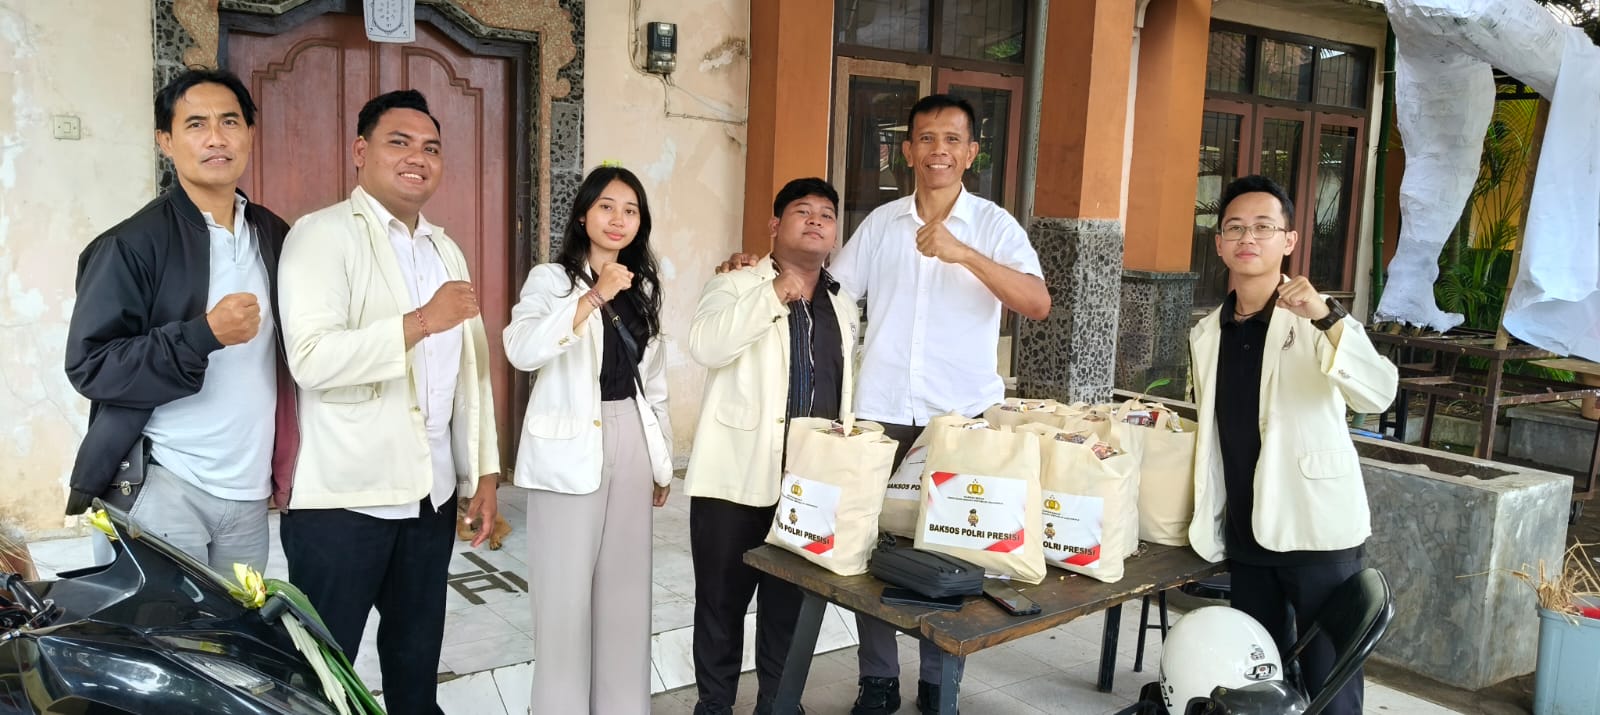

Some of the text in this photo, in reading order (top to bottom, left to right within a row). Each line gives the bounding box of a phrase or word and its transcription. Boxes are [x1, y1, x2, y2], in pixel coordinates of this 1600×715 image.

[784, 524, 803, 537] POLRI
[803, 531, 830, 545] PRESISI
[929, 523, 1020, 541] BAKSOS POLRI PRESISI
[1042, 540, 1096, 556] OLRI PRESISI
